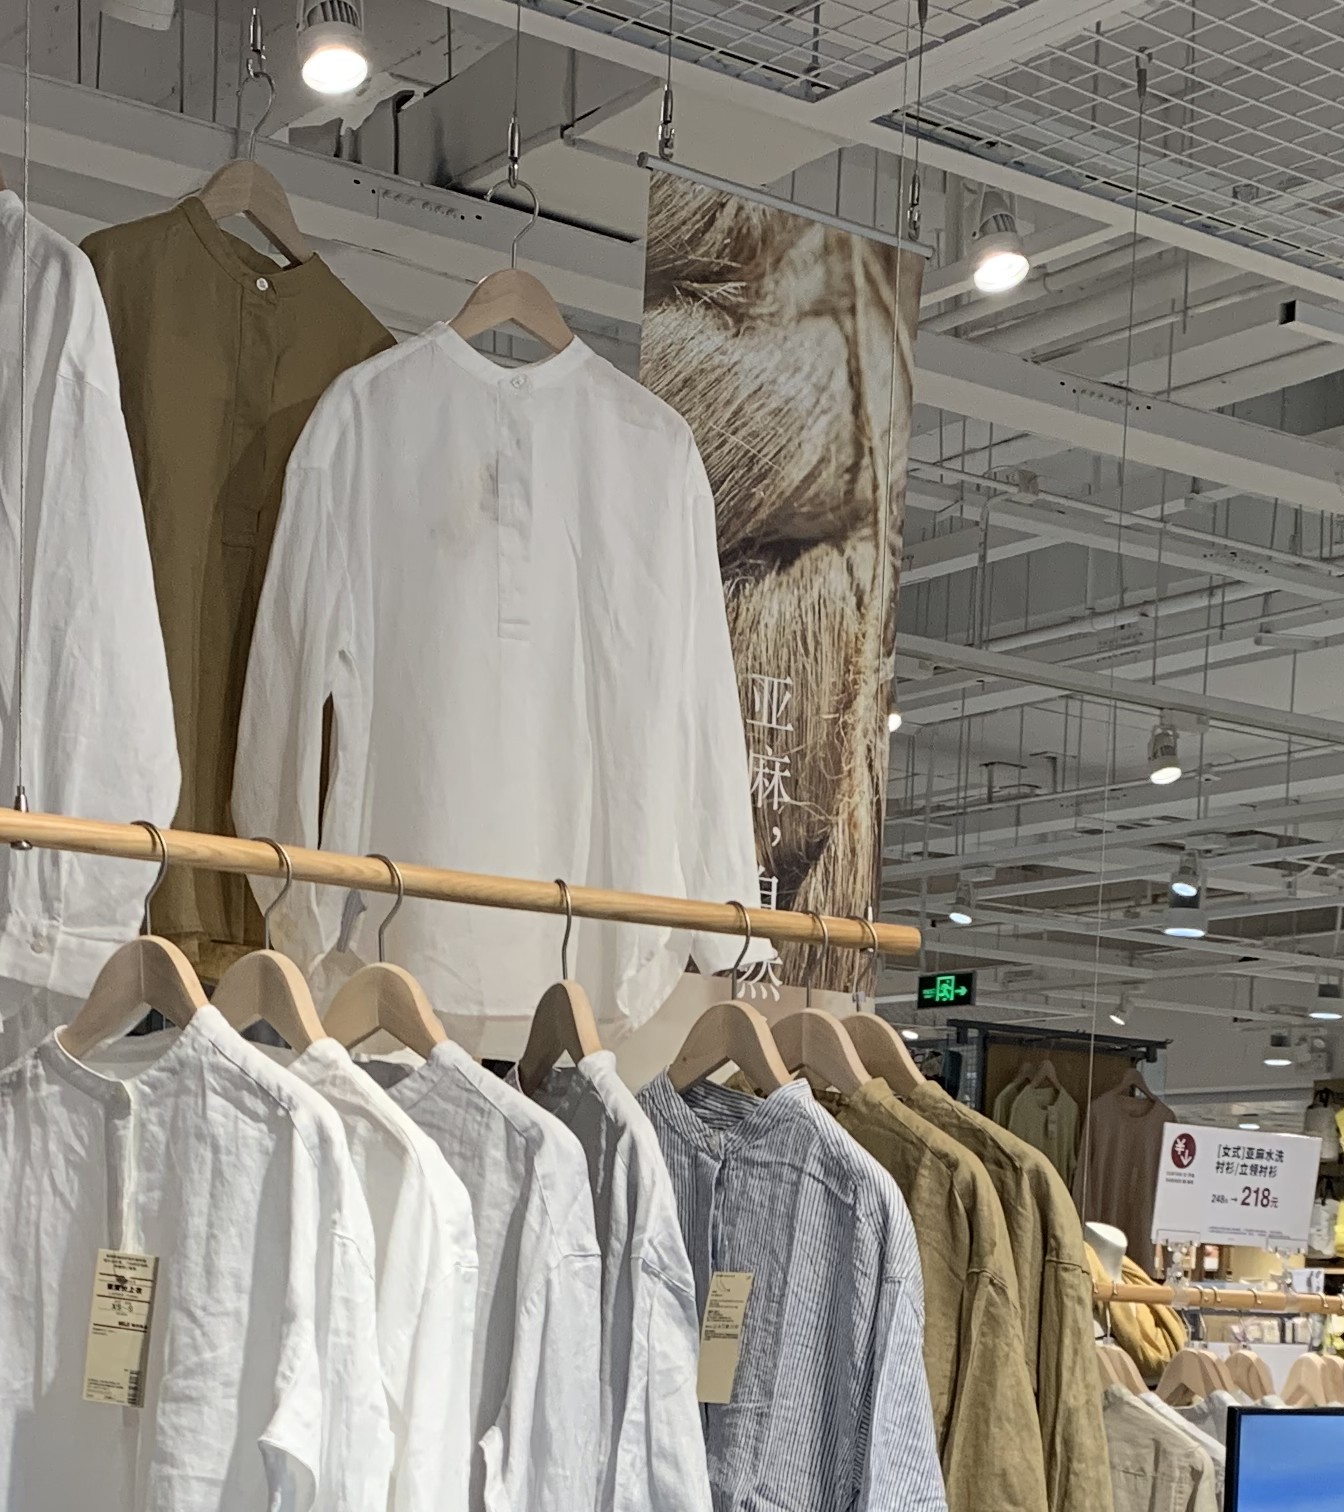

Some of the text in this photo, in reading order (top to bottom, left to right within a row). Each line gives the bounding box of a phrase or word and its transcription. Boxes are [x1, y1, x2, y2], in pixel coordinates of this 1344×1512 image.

[1217, 1144, 1284, 1163] [女式]亚麻水洗
[1240, 1186, 1278, 1208] 218元
